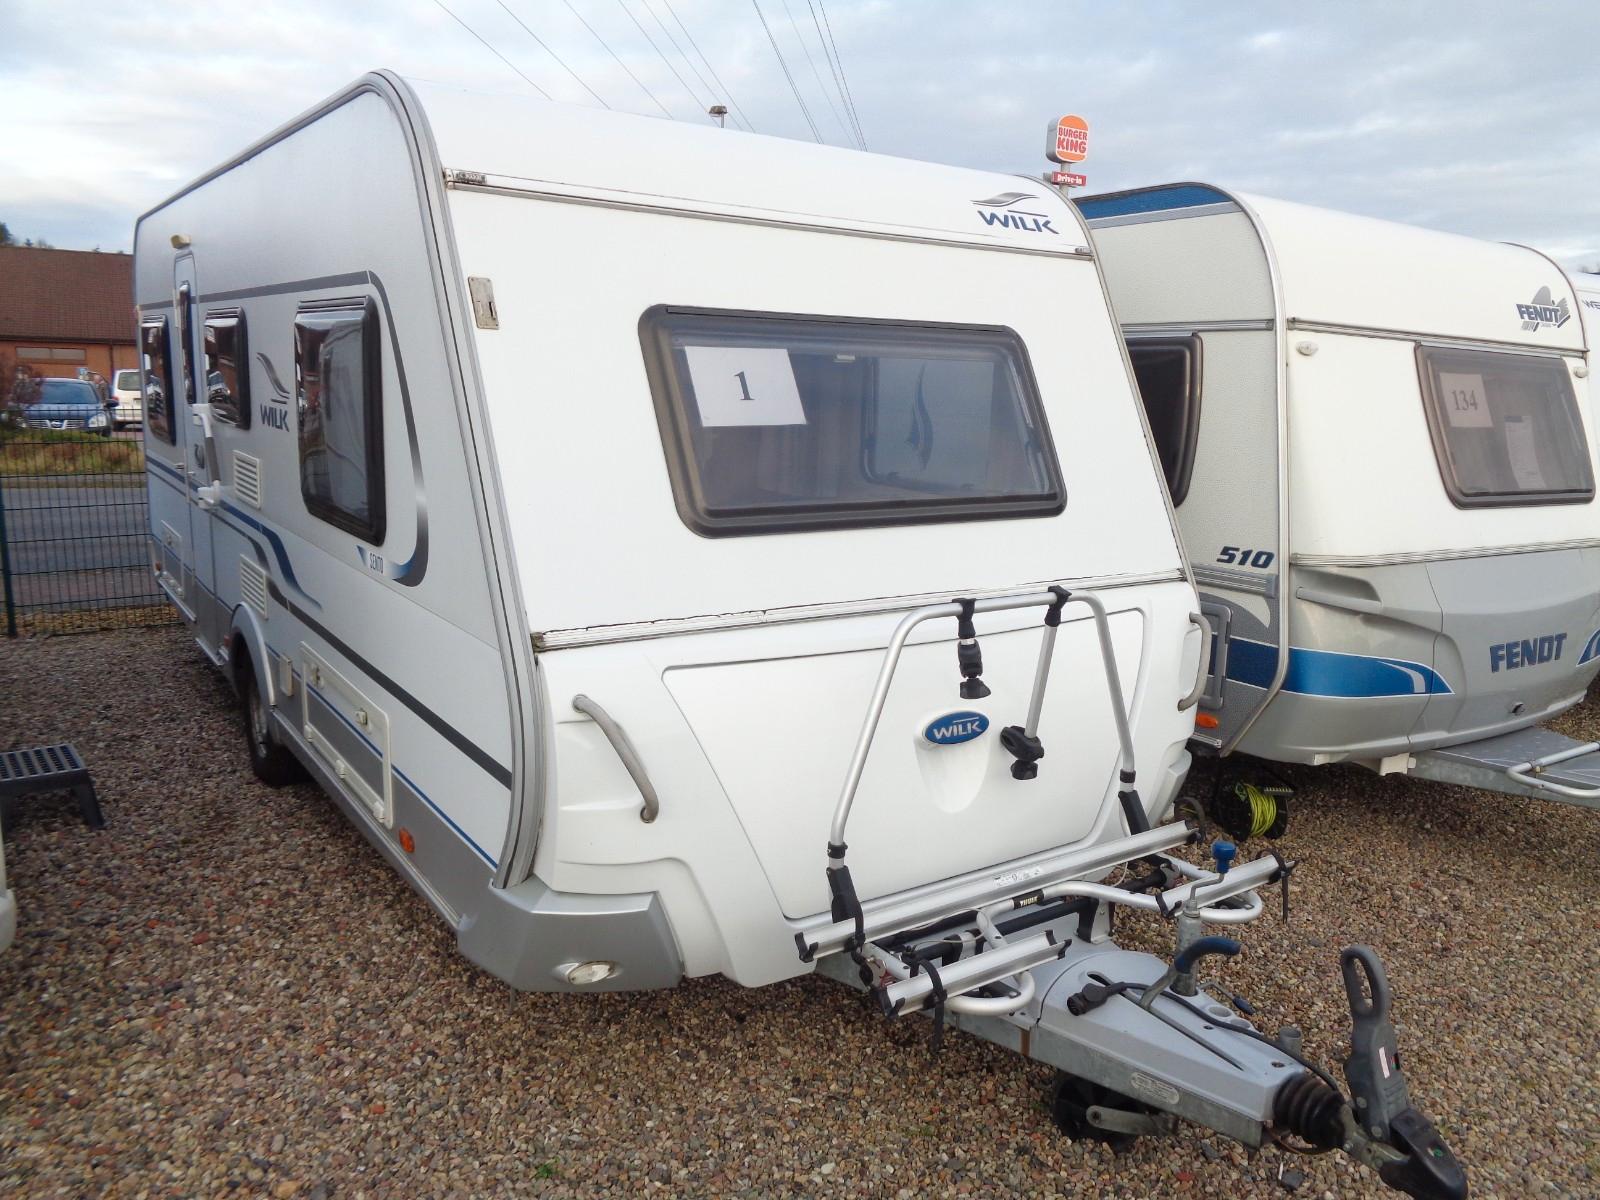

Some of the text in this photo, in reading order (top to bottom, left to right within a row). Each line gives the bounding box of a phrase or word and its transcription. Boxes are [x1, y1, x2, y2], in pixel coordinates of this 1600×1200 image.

[1058, 126, 1088, 141] BURGER
[1057, 136, 1087, 154] KING
[977, 210, 1060, 234] WILK
[1516, 303, 1561, 323] FENDT
[734, 371, 755, 401] 1
[1451, 389, 1478, 411] 134
[260, 403, 290, 432] WILK
[1216, 546, 1275, 569] 510
[1489, 632, 1568, 673] FENDT
[933, 720, 982, 740] WILK
